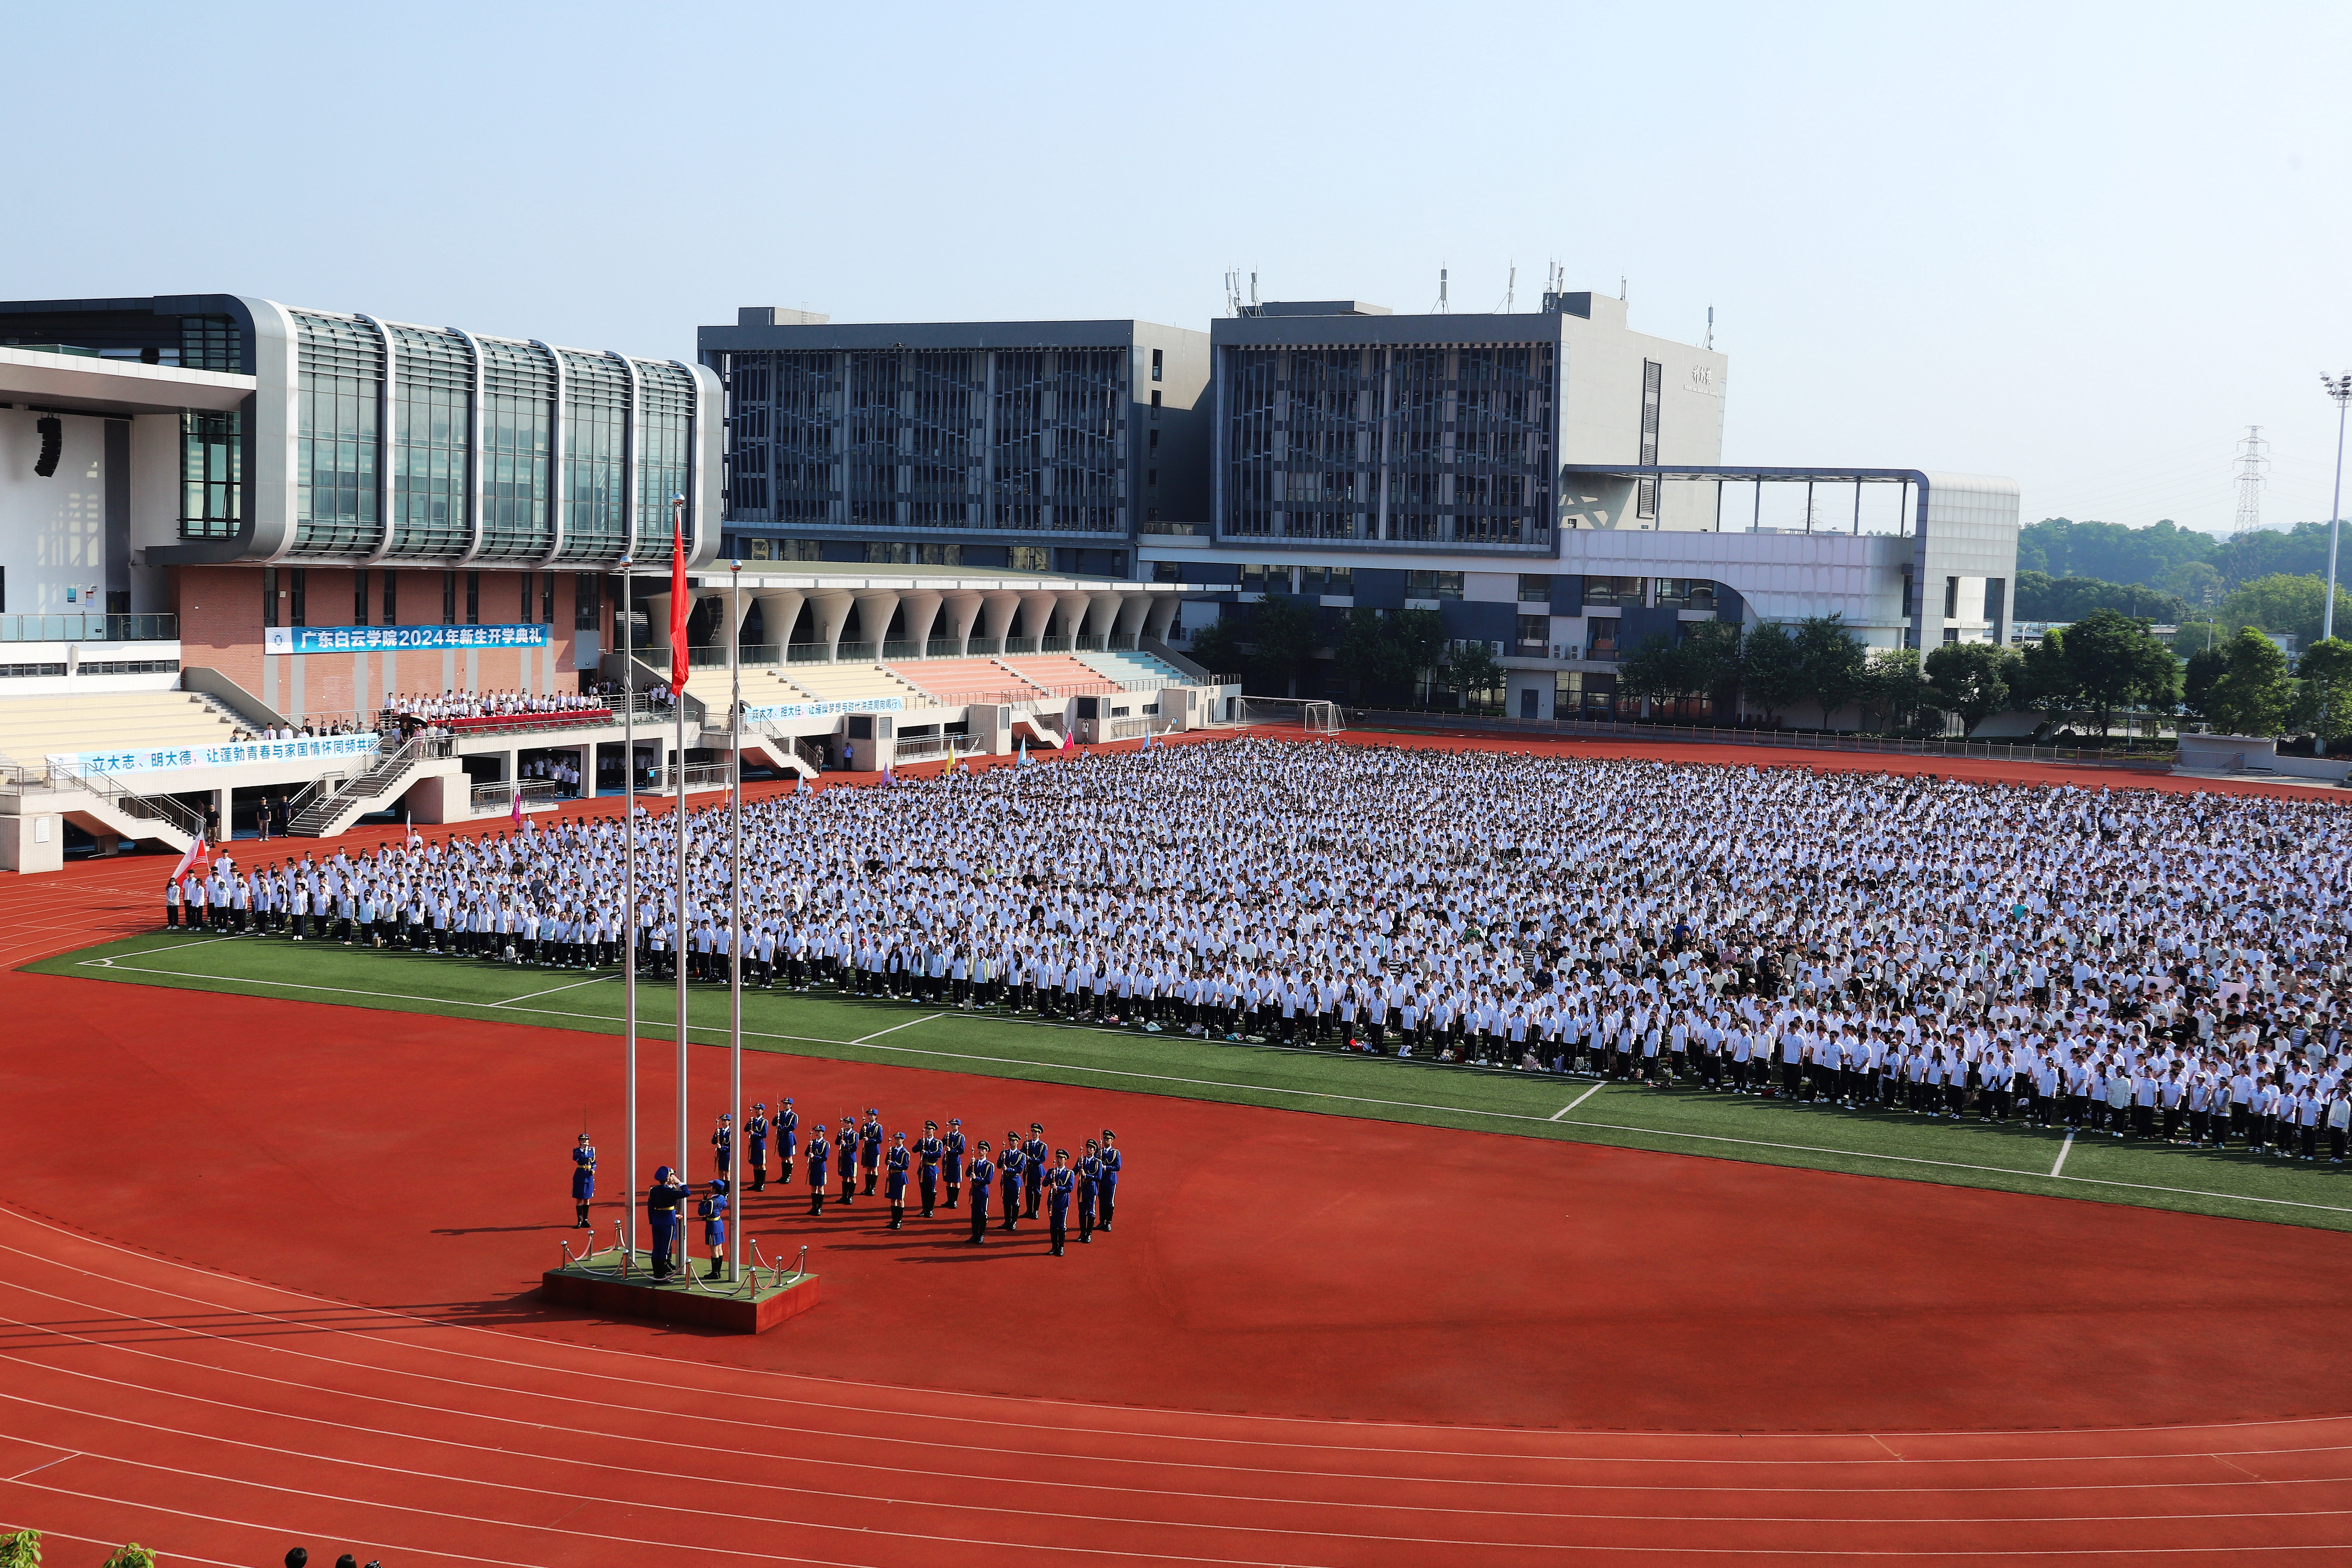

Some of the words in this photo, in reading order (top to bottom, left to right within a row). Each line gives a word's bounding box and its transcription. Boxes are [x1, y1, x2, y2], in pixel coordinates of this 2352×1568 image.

[301, 628, 542, 648] 广东白云学院2024年新生开学典礼
